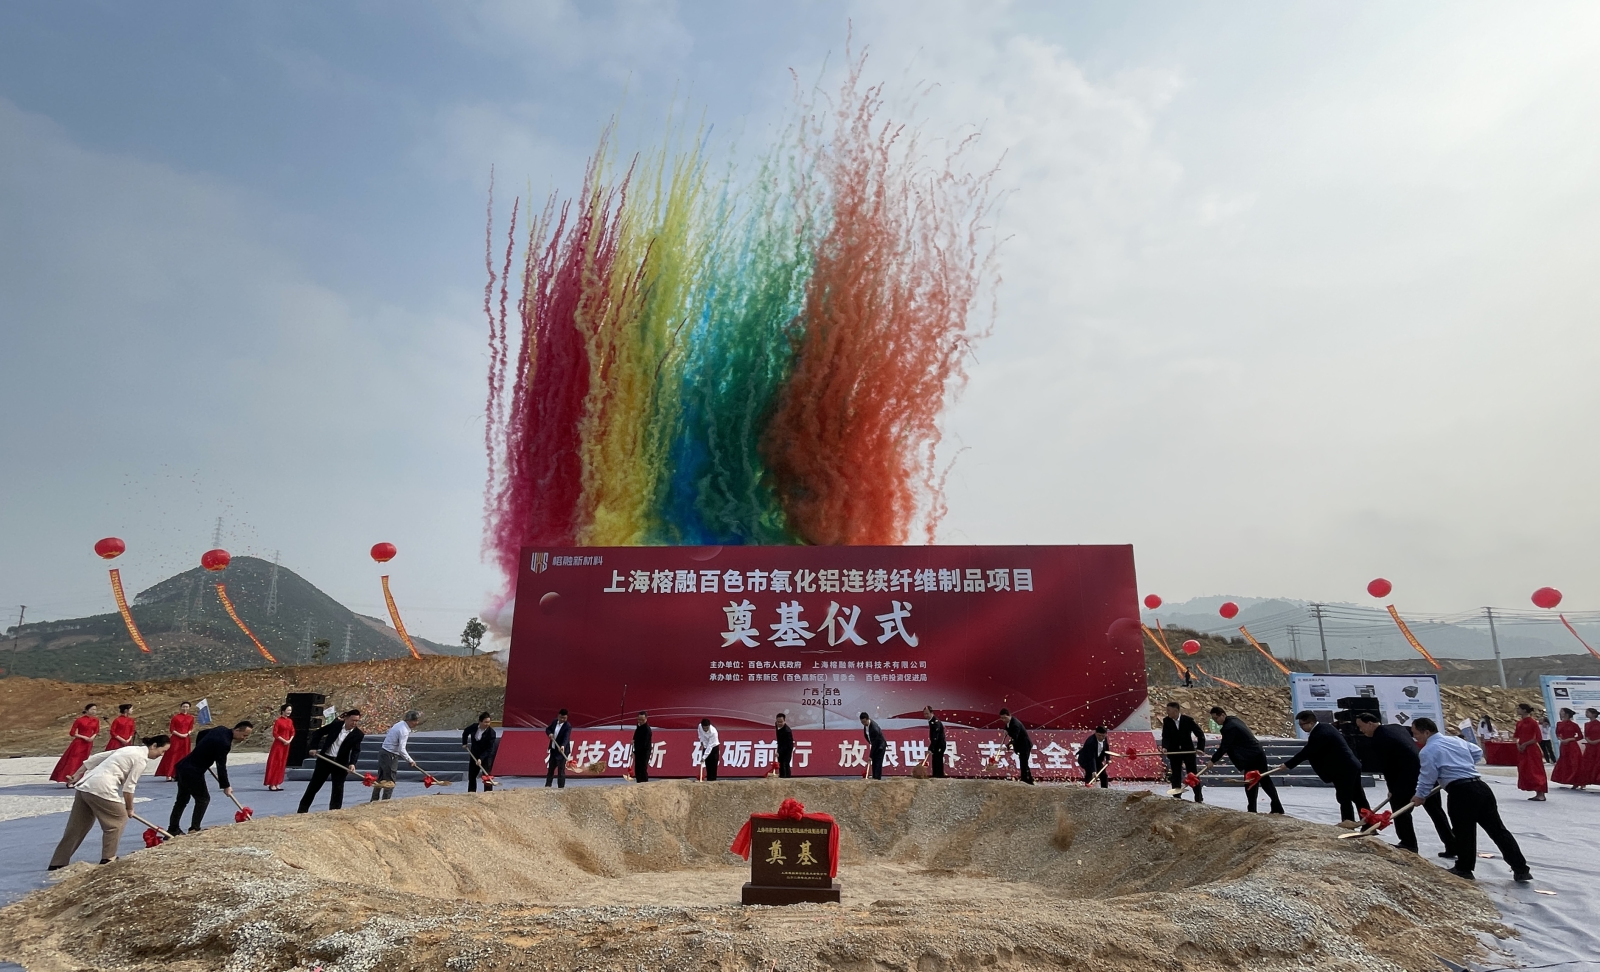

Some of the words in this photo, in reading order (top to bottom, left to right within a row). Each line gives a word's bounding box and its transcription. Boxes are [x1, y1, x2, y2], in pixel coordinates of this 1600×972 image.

[552, 556, 604, 566] 榕融新材料
[603, 568, 1034, 594] 上海榕融百色市氧化铝连续纤维制品项目
[720, 599, 920, 648] 奠基仪式
[812, 660, 928, 669] 上海榕融新材料技术有限公司
[865, 673, 928, 682] 百色市投资促进局
[977, 740, 1085, 769] 志在全
[766, 839, 818, 866] 奠基
